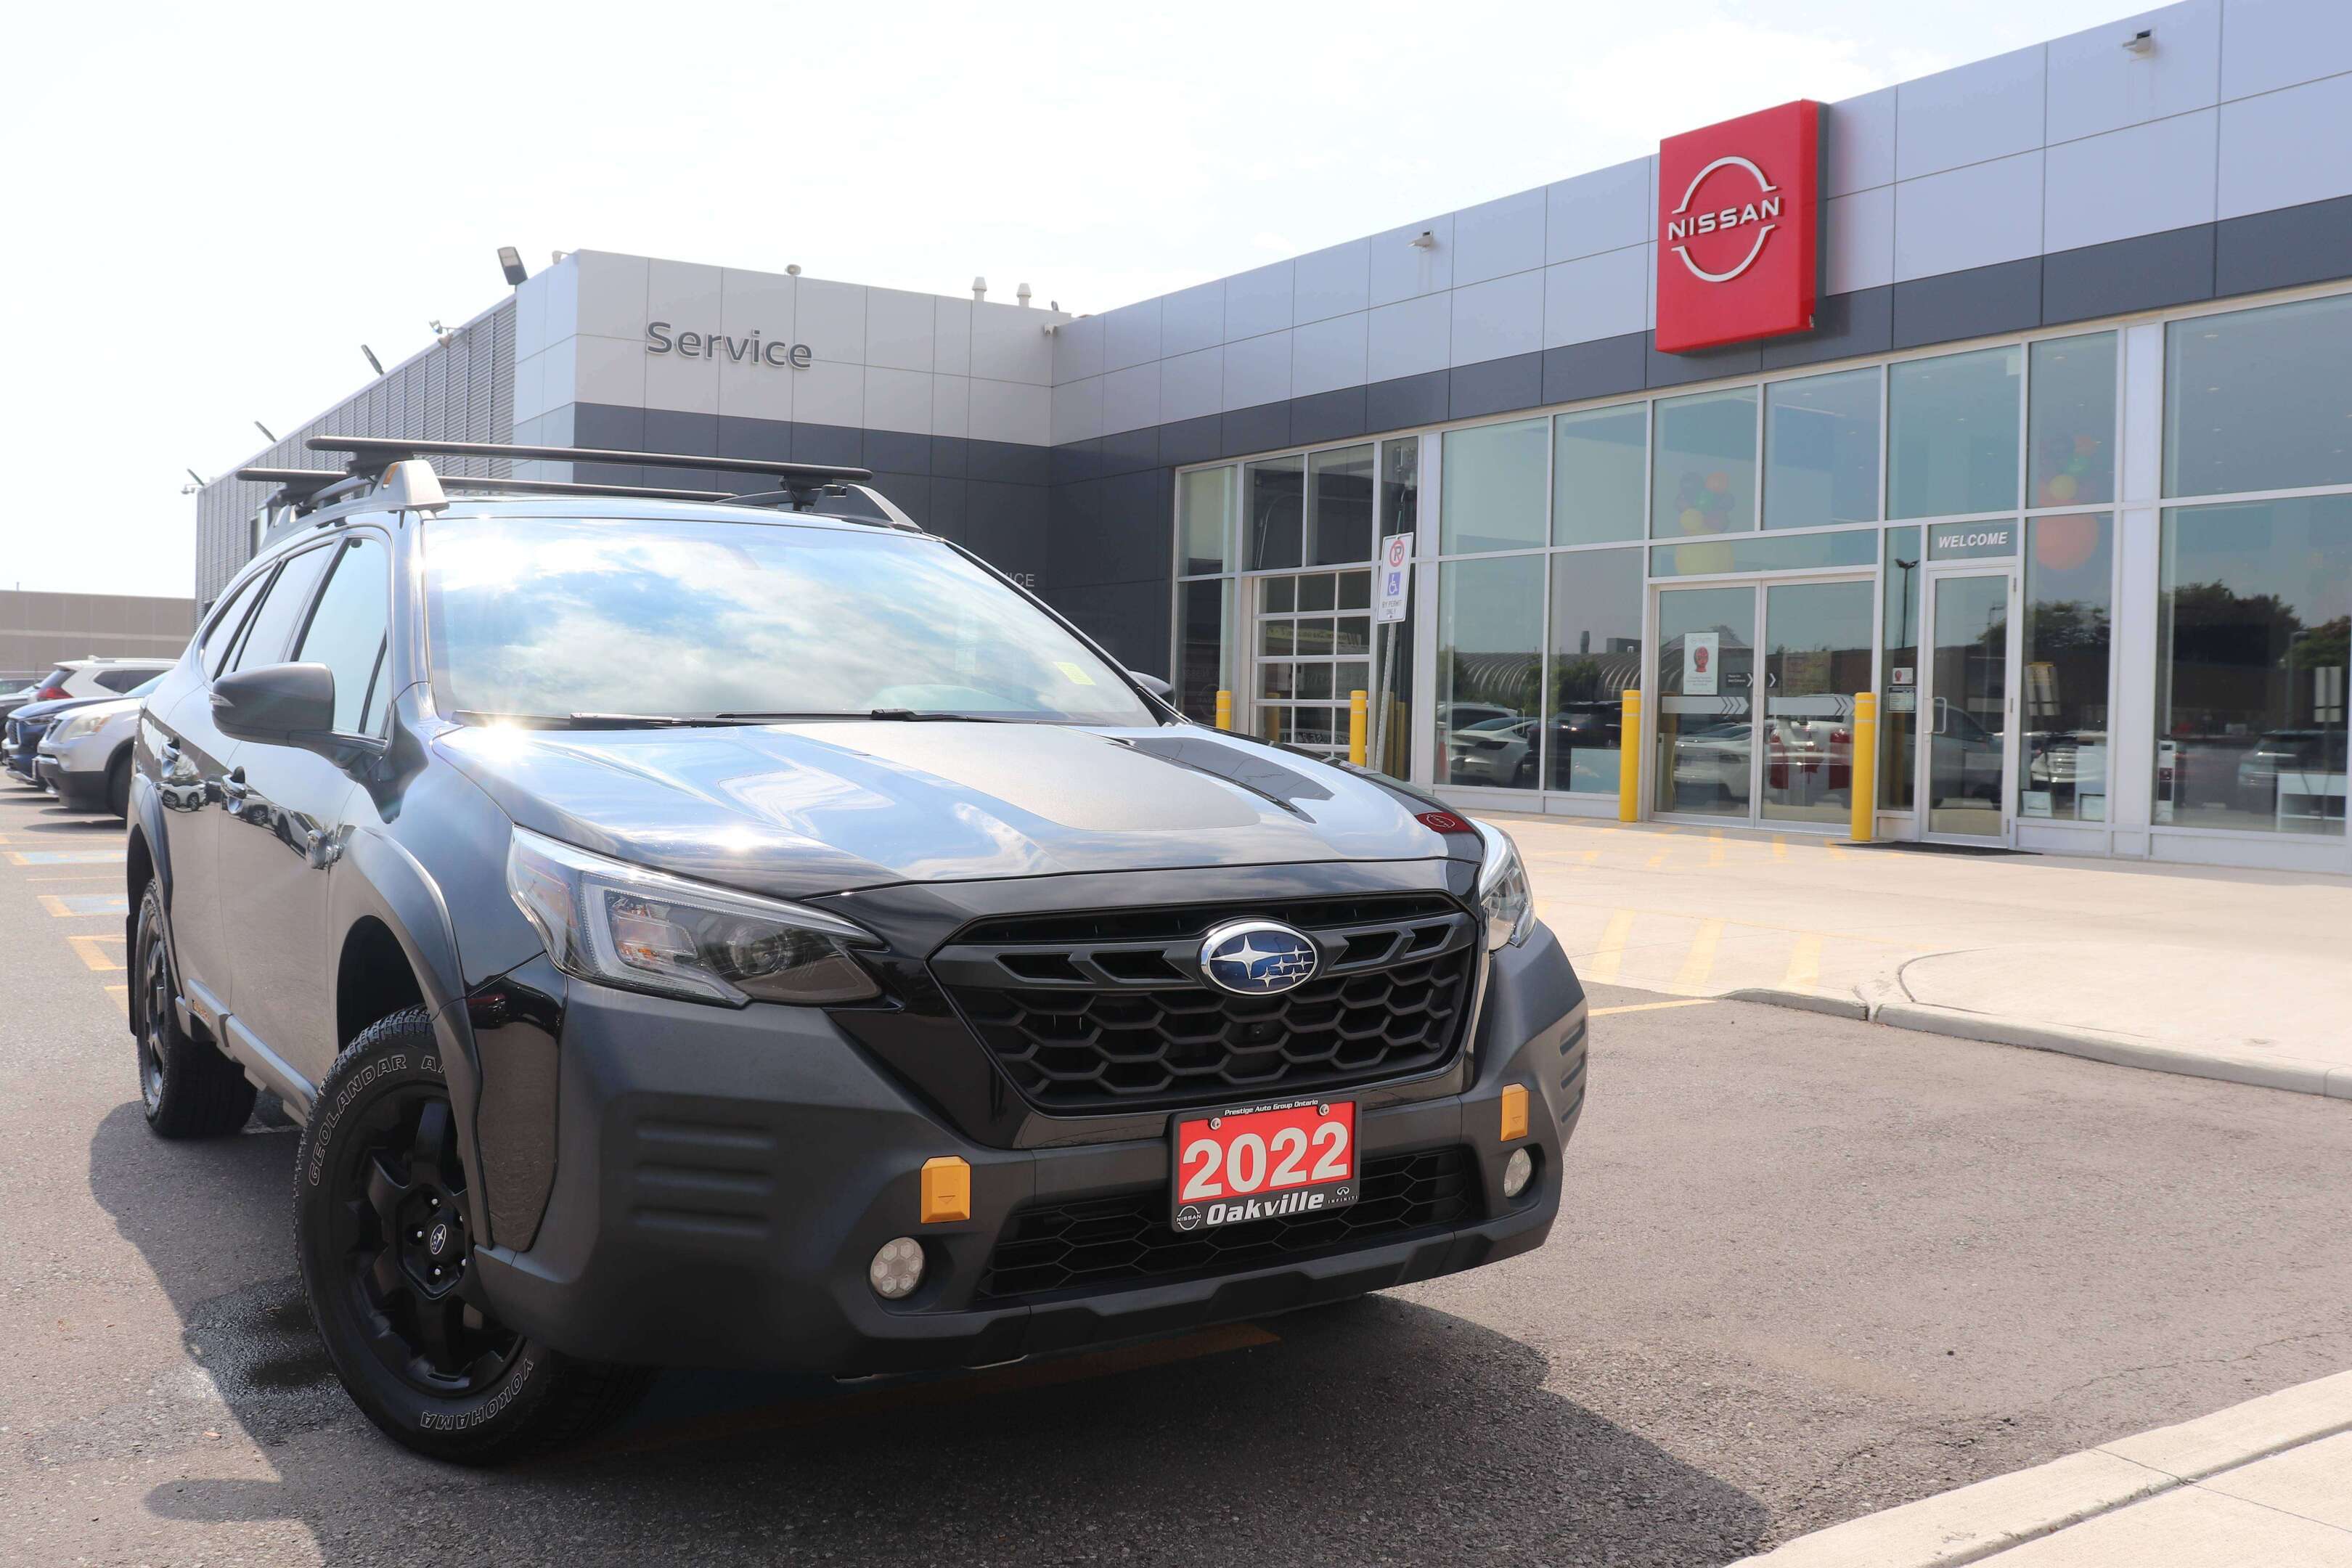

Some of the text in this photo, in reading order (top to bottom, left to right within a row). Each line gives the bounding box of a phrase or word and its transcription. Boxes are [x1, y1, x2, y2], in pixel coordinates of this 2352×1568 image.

[1668, 196, 1780, 241] NISSAN
[647, 321, 812, 369] Service
[1939, 531, 2009, 548] WELCOME
[309, 1054, 407, 1185] GEOLANDAR
[1182, 1122, 1349, 1200] 2022
[1206, 1191, 1325, 1225] Oakville
[1328, 1195, 1358, 1204] INFINITI
[420, 1358, 534, 1430] YOKOHAMA
